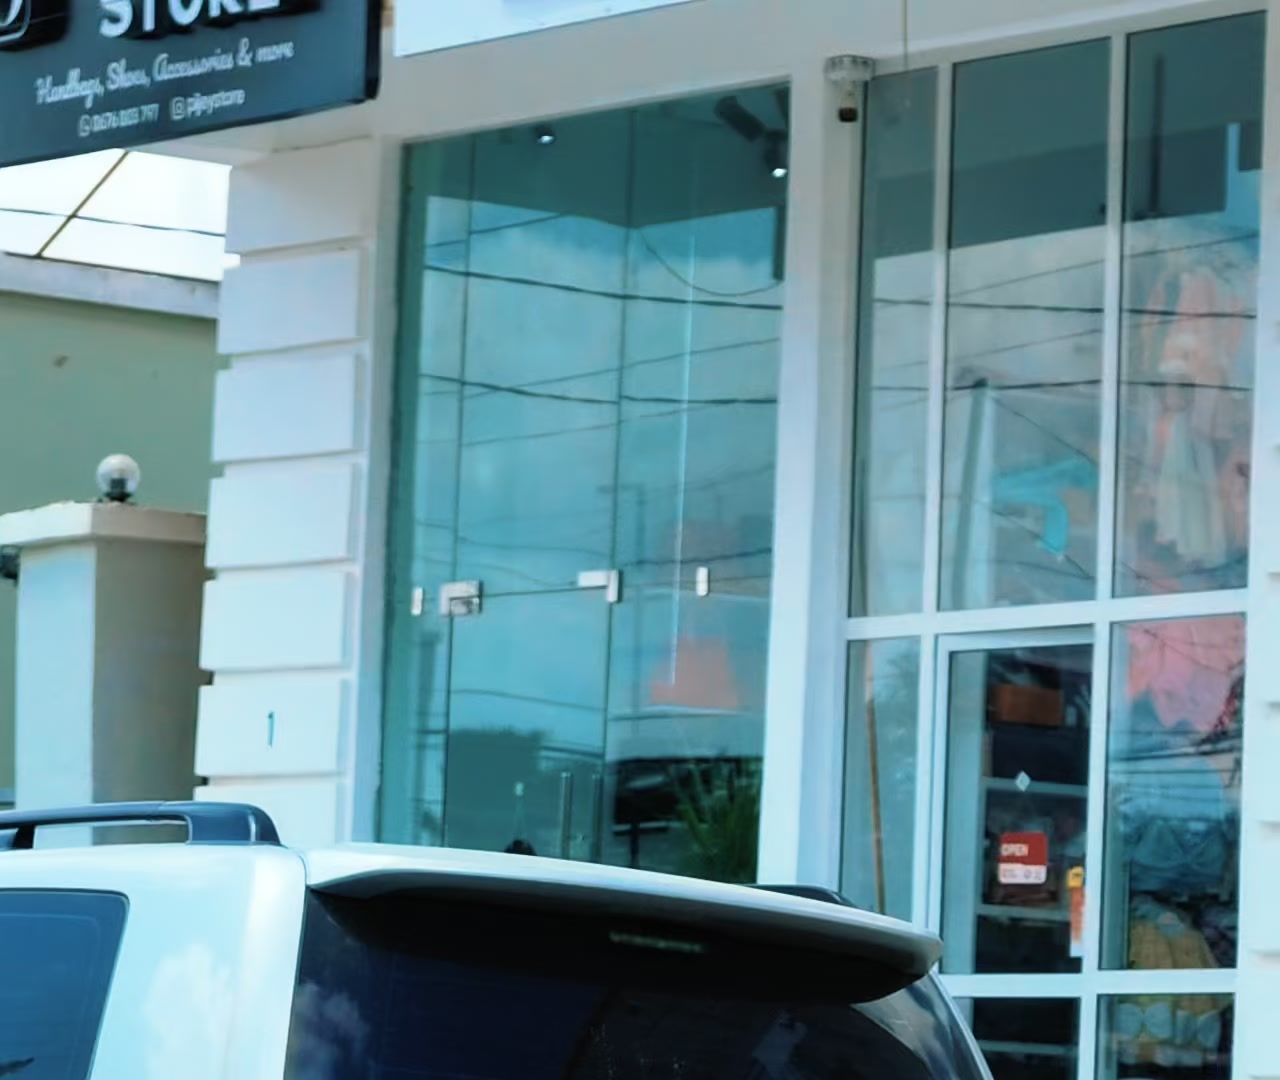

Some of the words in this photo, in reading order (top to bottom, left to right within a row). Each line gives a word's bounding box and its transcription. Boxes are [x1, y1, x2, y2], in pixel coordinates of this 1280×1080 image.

[107, 58, 151, 91] Shoes,
[153, 48, 234, 82] Accessories
[236, 37, 253, 67] &
[255, 41, 295, 63] more
[266, 711, 276, 747] 1
